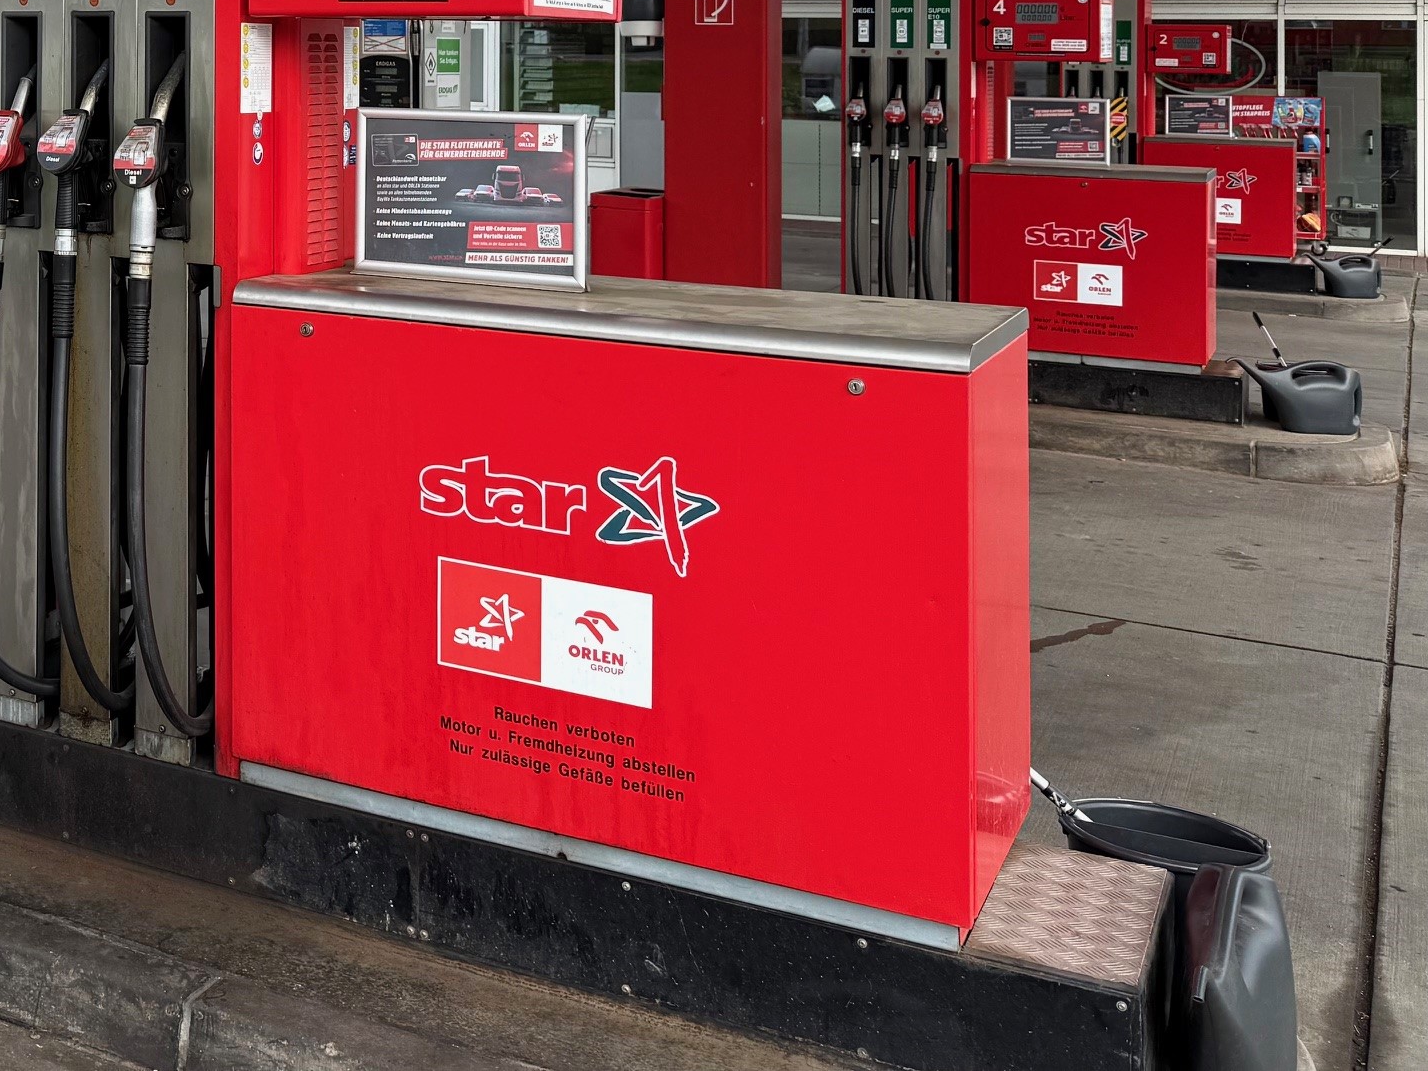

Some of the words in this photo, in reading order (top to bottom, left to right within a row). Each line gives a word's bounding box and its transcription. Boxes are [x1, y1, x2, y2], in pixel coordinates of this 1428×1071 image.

[992, 0, 1007, 15] 4
[1159, 34, 1168, 44] 2
[432, 141, 450, 149] STAR
[1024, 221, 1096, 249] star
[504, 255, 536, 263] GÜNSTIG
[537, 256, 569, 264] TANKEN!
[419, 455, 587, 536] star
[453, 626, 505, 652] star
[568, 644, 624, 667] ORLEN
[590, 663, 624, 676] GROUP
[494, 705, 559, 732] Rauchen
[565, 723, 635, 748] verboten
[439, 714, 482, 737] Motor
[488, 729, 502, 741] u.
[508, 732, 615, 768] Fremdheizung
[621, 757, 696, 783] abstellen
[449, 738, 474, 756] Nur
[481, 746, 551, 775] zulässige
[558, 761, 614, 787] Gefäße
[621, 776, 685, 803] befüllen
